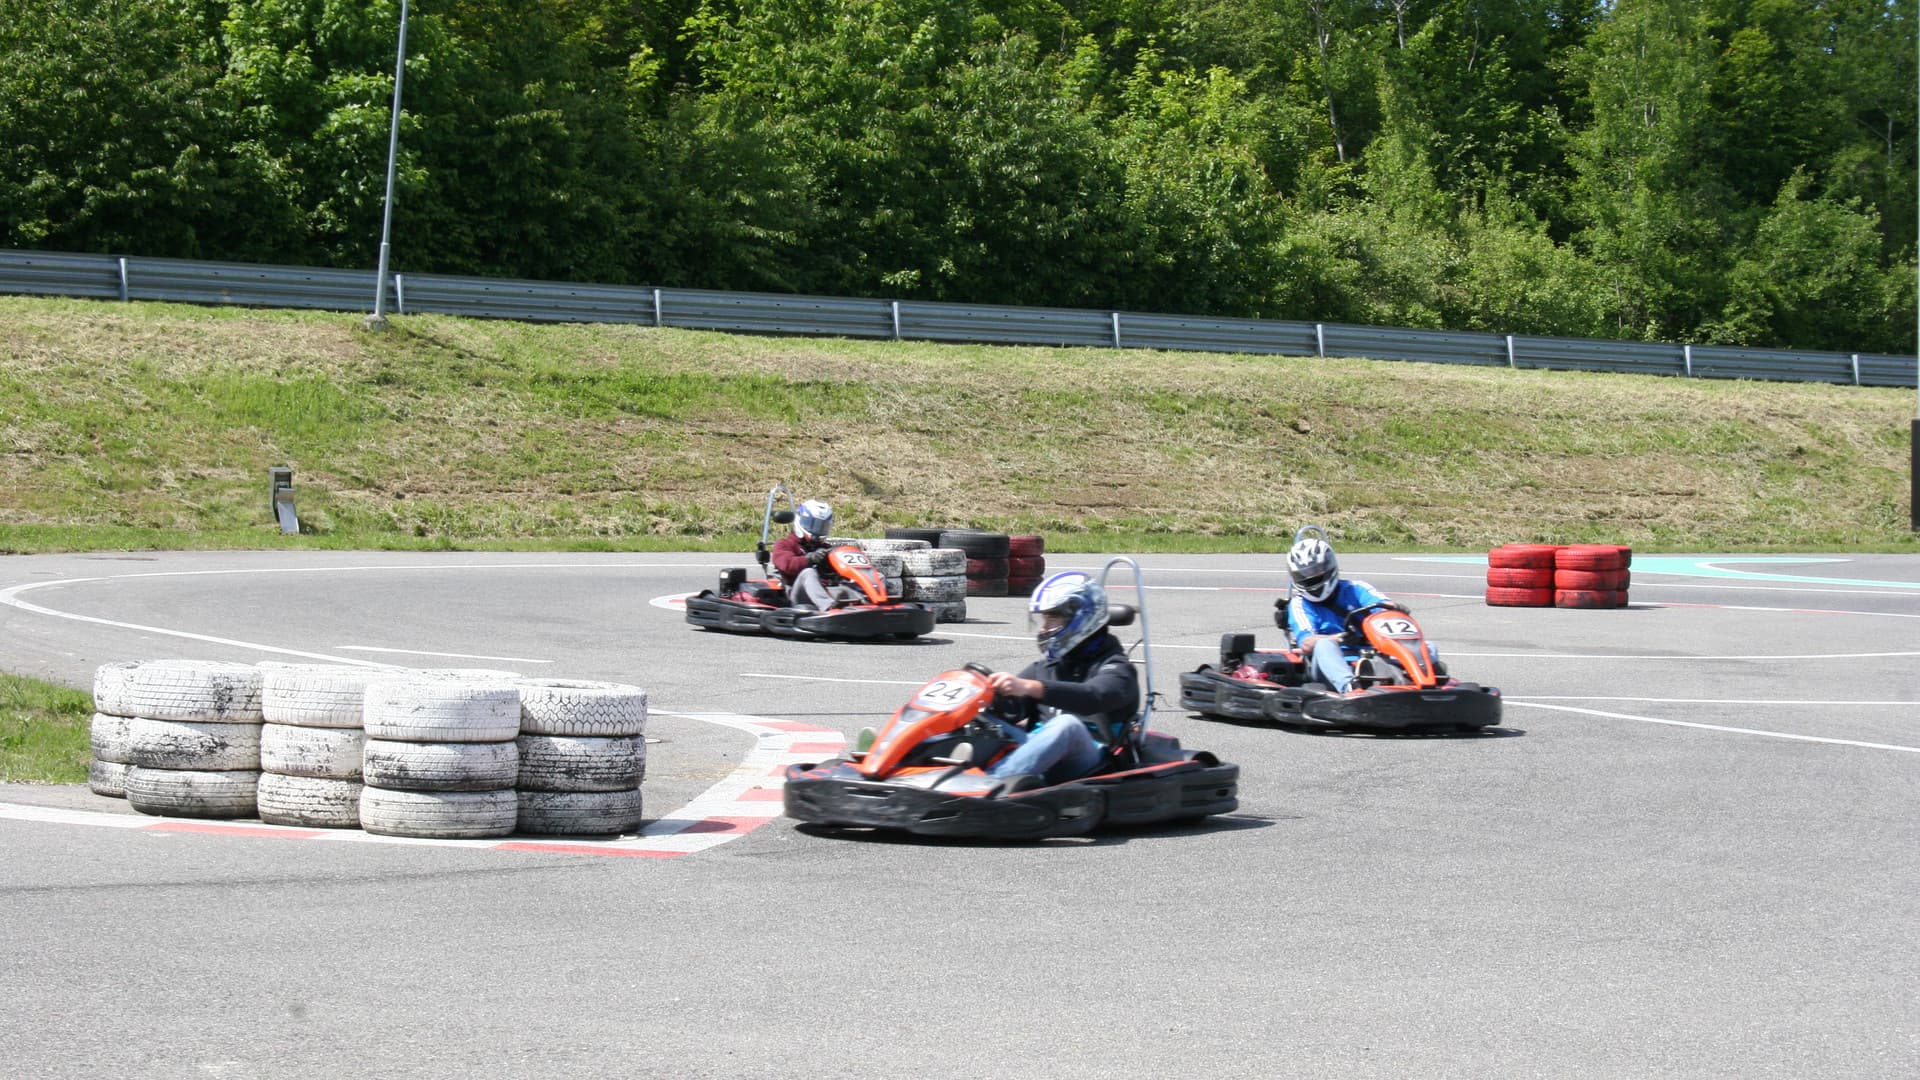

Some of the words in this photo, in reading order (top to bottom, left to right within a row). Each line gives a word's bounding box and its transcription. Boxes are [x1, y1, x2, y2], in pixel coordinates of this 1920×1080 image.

[843, 554, 869, 565] 20
[1380, 621, 1413, 635] 12
[923, 682, 964, 701] 24
